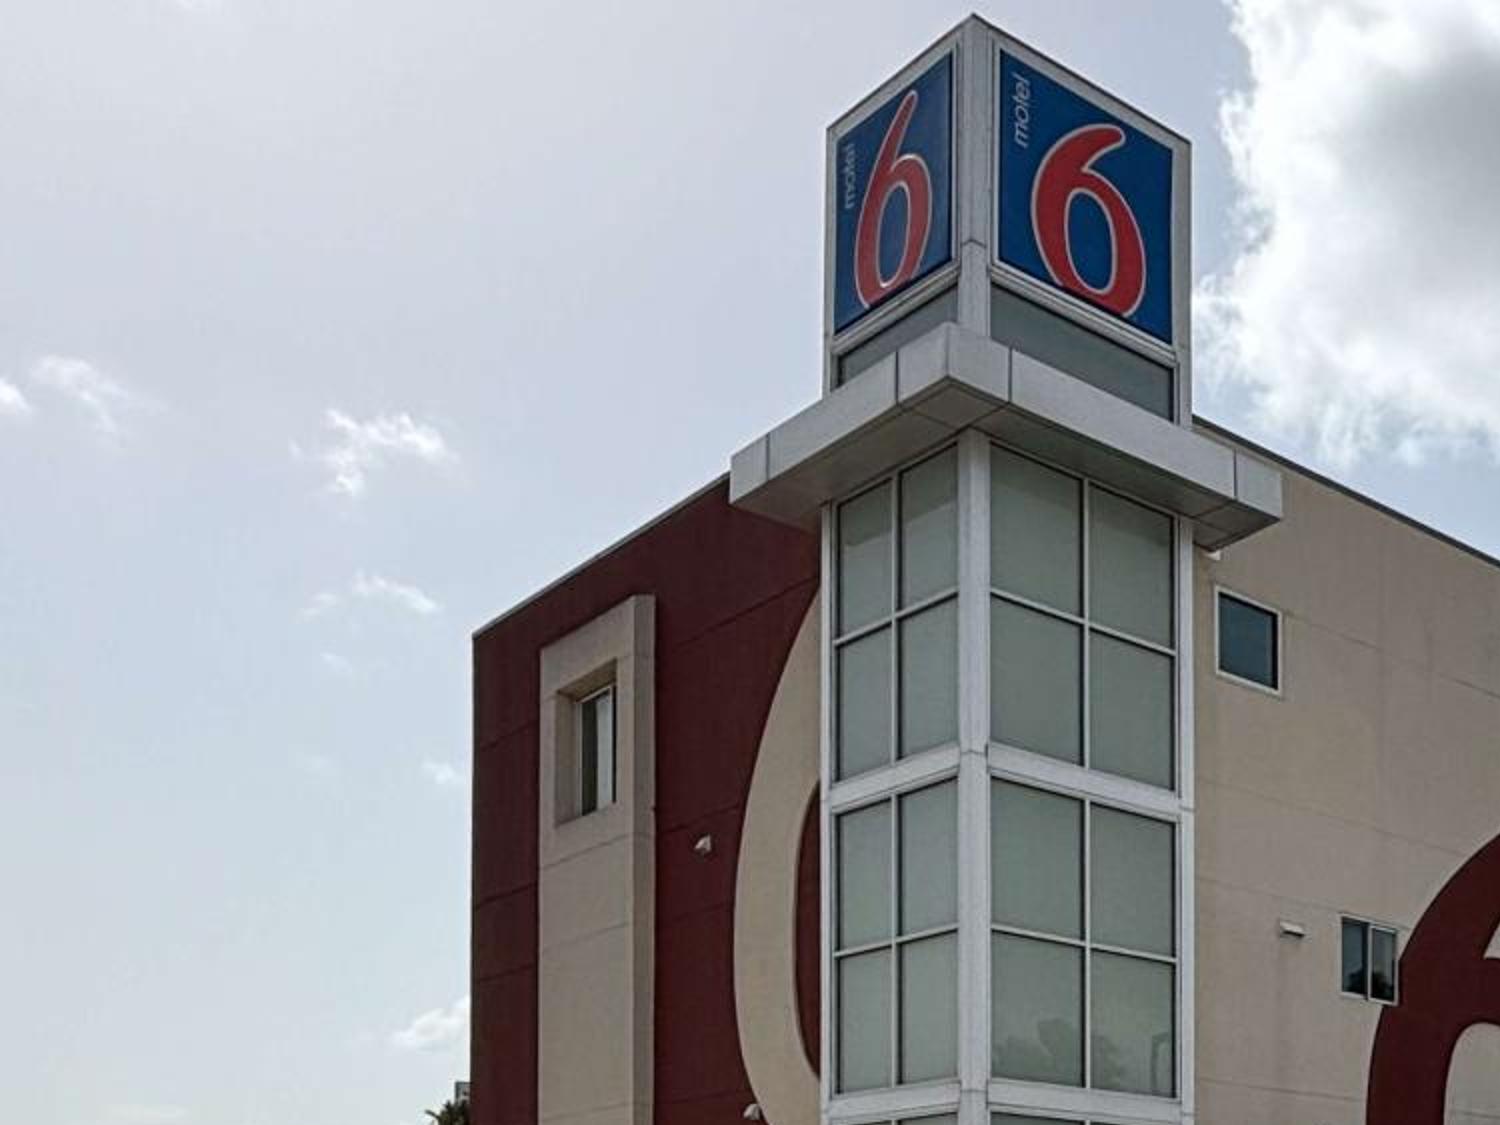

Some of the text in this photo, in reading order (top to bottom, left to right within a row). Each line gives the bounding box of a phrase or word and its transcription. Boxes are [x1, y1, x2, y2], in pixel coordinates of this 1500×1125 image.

[854, 89, 933, 310] 6
[1012, 71, 1032, 149] motel
[1030, 123, 1147, 318] 6
